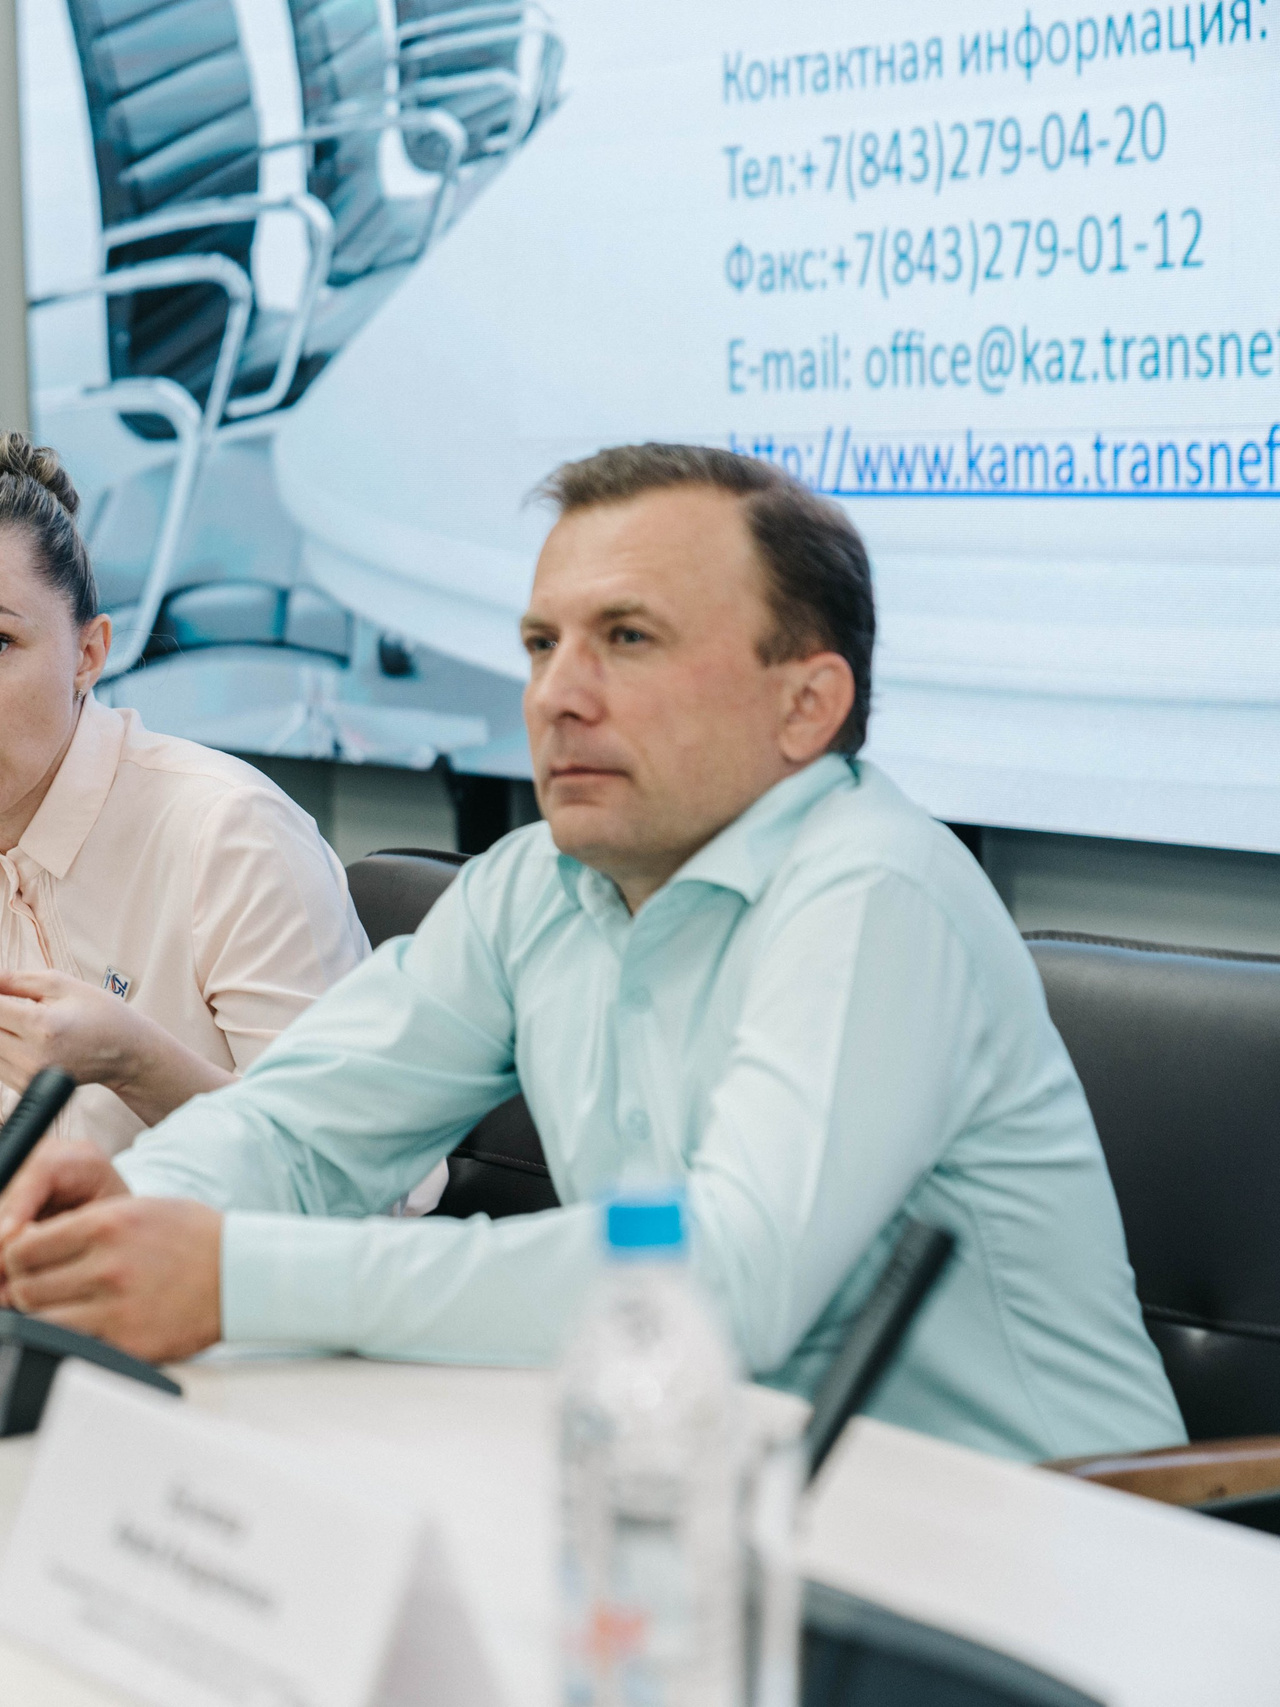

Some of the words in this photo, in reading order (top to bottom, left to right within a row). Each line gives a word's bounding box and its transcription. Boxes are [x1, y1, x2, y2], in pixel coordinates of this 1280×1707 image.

[722, 36, 944, 103] Контактная
[959, 0, 1268, 82] информация:
[723, 100, 1167, 201] Тел:+7(843)279-04-20
[724, 206, 1204, 299] Факс:+7(843)279-01-12
[728, 332, 852, 394] E-mail:
[864, 324, 1280, 395] office@kaz.transne
